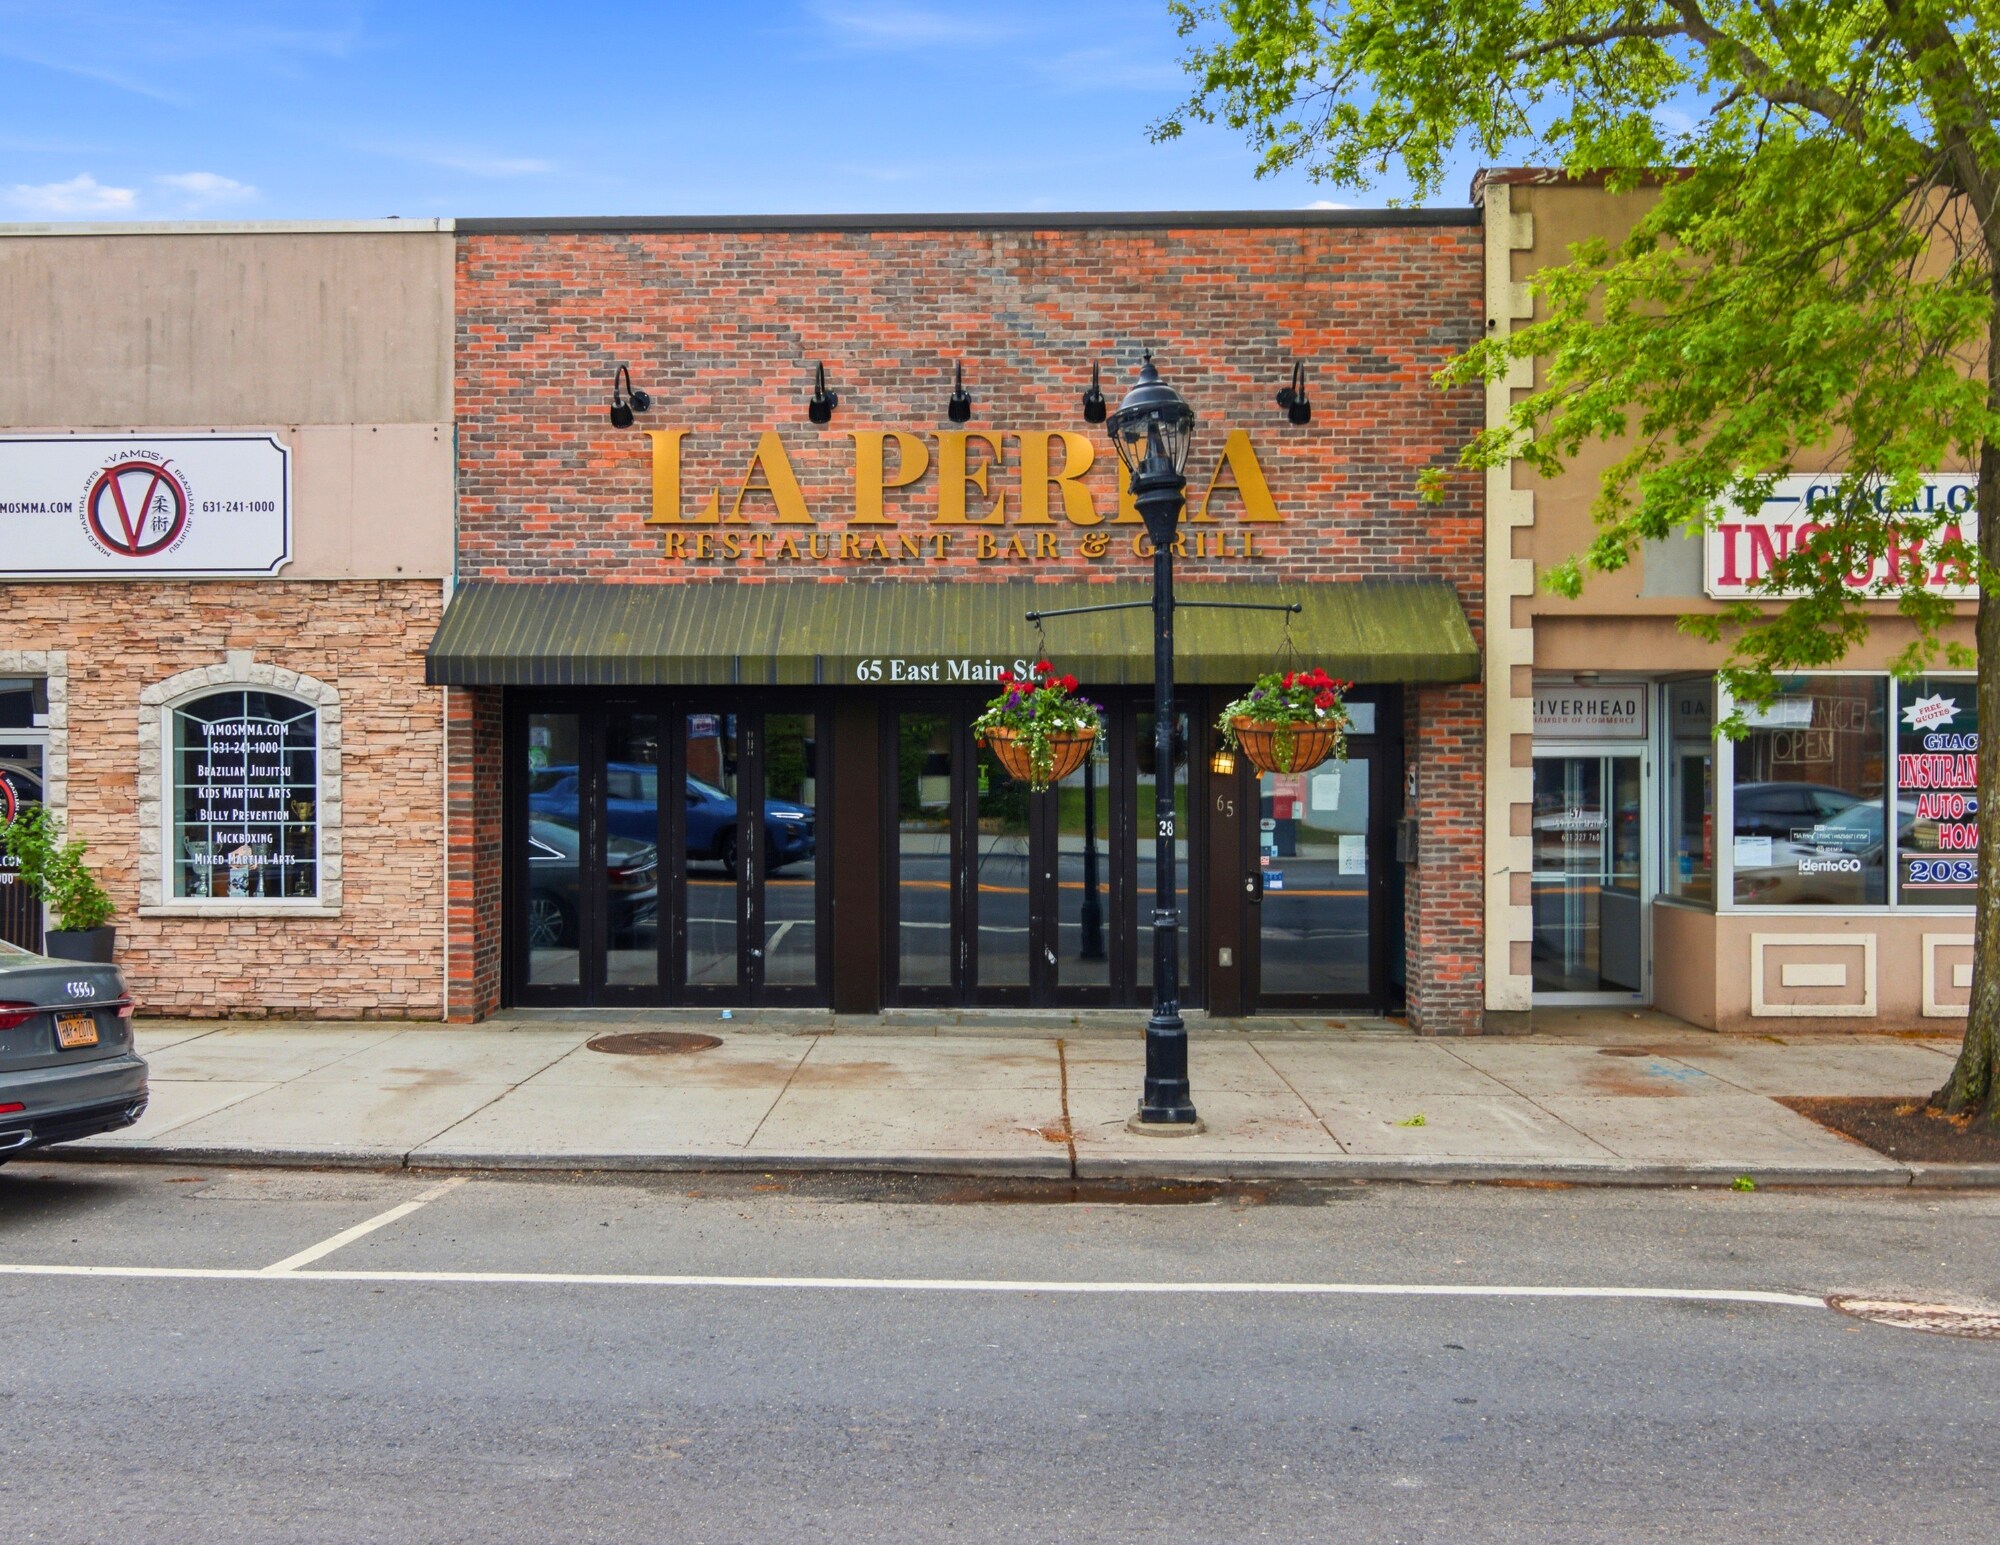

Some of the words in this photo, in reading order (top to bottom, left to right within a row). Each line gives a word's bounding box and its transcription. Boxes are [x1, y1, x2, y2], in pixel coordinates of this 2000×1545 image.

[108, 449, 160, 462] VAMOS
[84, 470, 99, 493] ARTS
[643, 429, 816, 525] LA
[174, 469, 195, 515] BRAZILIAN
[0, 502, 72, 514] MOSMMA.COM
[79, 494, 89, 535] MARTIAL
[202, 501, 275, 512] 631-241-1000
[88, 535, 111, 557] MIXED
[664, 531, 951, 559] RESTAURANT
[976, 531, 1060, 559] BAR
[1079, 531, 1110, 558] &
[1132, 531, 1262, 558] GRILL
[857, 660, 883, 681] 65
[889, 660, 940, 681] East
[946, 660, 1005, 681] Main
[1915, 708, 1950, 723] QUOTES
[1918, 703, 1942, 715] FREE
[202, 724, 289, 736] VAMOSMMA.COM
[213, 742, 278, 754] 631-241-1000
[1774, 731, 1831, 759] OPEN
[1216, 794, 1234, 818] 65
[1916, 794, 1965, 819] AUTO
[1159, 821, 1174, 837] 28
[1798, 859, 1861, 872] IdentoGO
